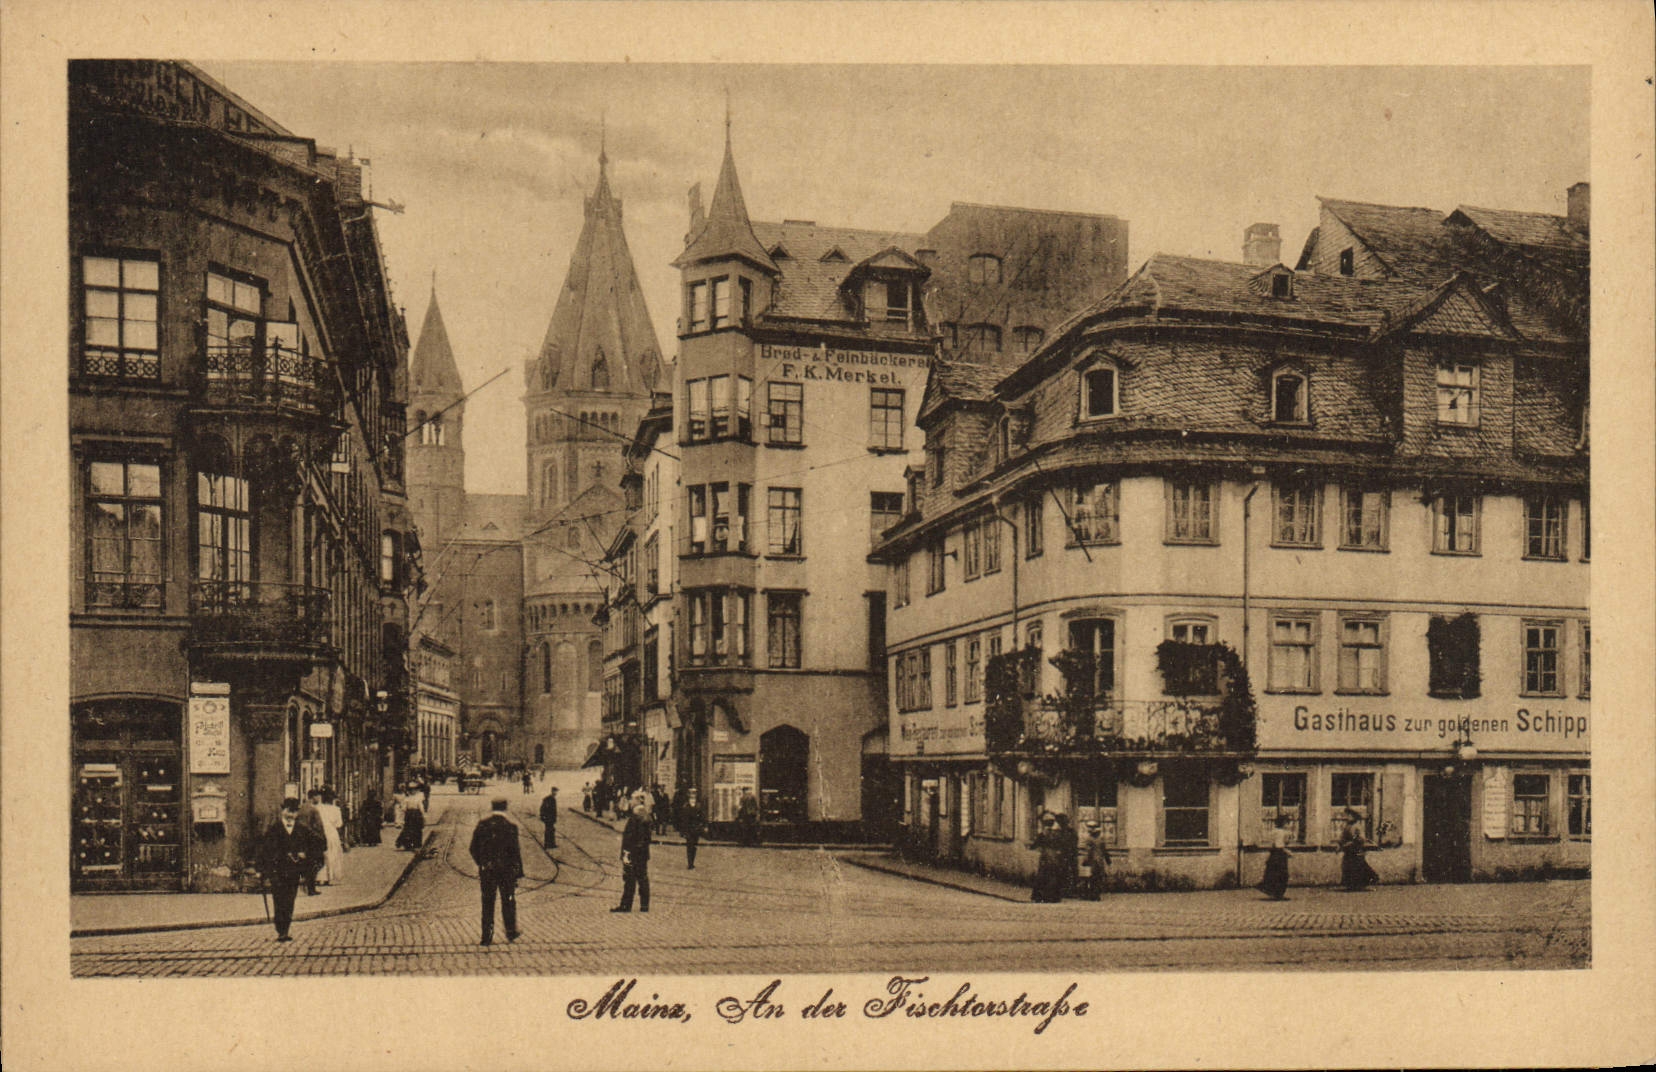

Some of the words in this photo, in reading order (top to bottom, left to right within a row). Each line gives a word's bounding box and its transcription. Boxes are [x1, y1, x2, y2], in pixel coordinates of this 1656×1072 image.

[1294, 705, 1396, 732] Gasthaus
[1404, 717, 1432, 733] zur
[1438, 715, 1508, 738] goldenen
[1516, 708, 1587, 739] Schipp
